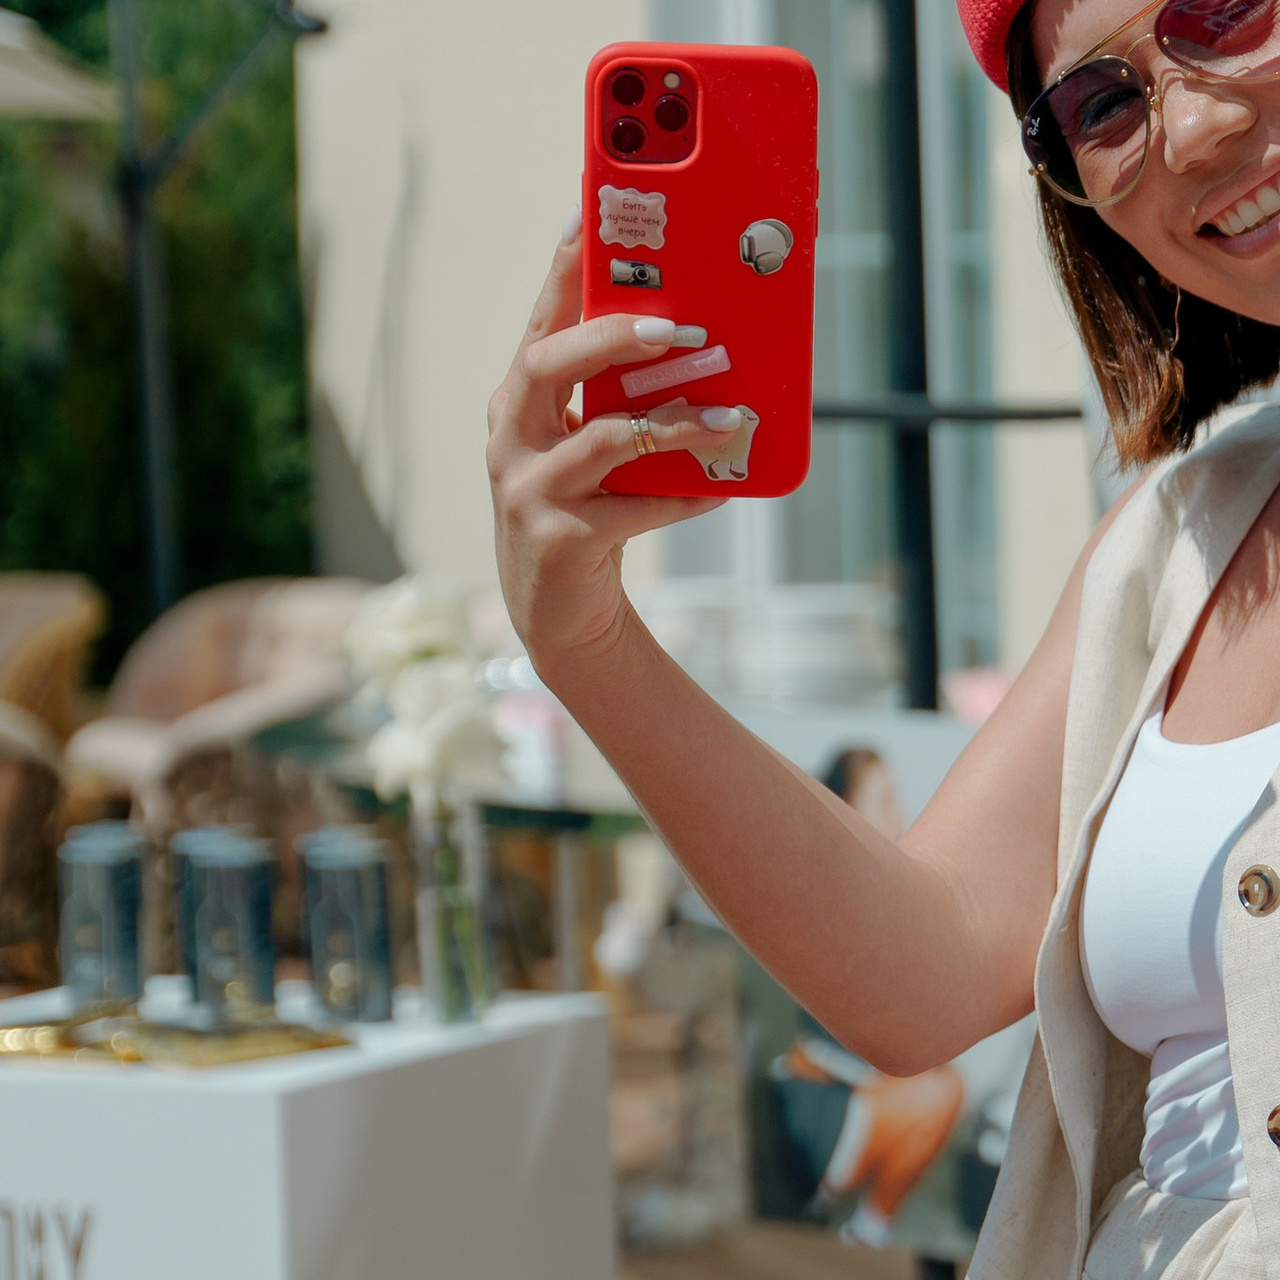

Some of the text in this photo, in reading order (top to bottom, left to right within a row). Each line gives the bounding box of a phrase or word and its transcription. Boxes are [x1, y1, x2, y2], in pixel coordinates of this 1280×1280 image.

[622, 198, 647, 211] Быть
[606, 213, 660, 226] лучше чем
[618, 227, 646, 239] вчера
[628, 354, 720, 391] PROSECCO
